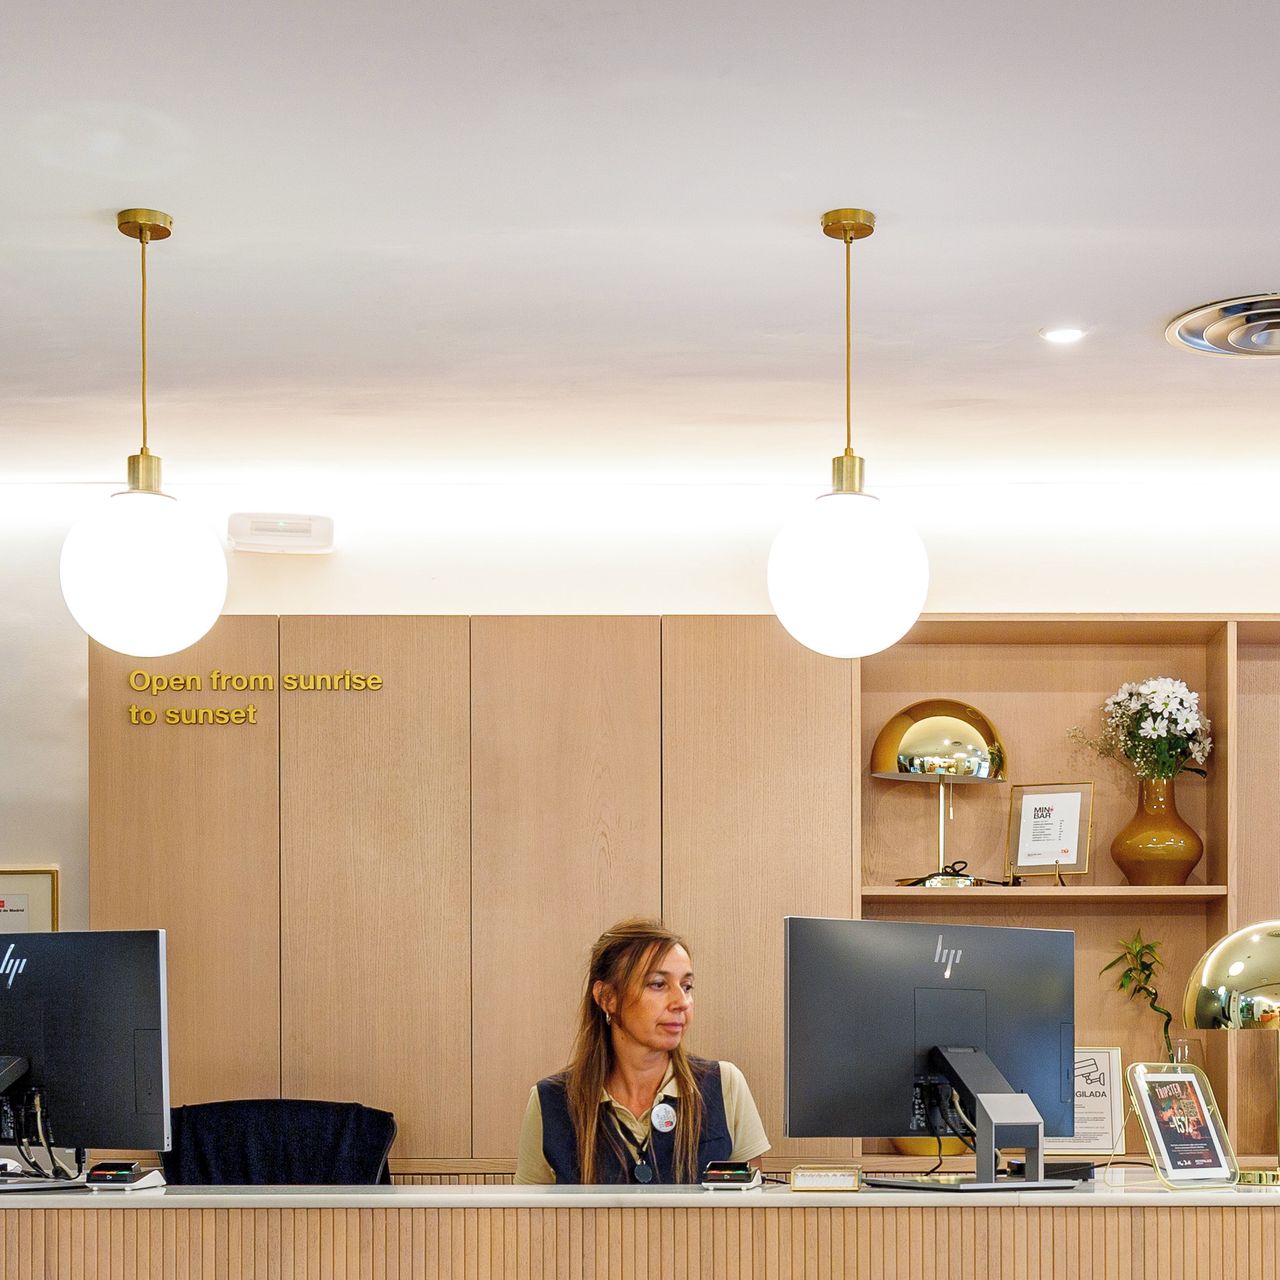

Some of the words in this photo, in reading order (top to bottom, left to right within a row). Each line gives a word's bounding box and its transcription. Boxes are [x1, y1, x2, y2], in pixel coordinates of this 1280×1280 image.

[128, 668, 202, 695] Open
[210, 668, 274, 691] from
[282, 669, 384, 691] sunrise
[128, 703, 157, 725] to
[164, 703, 257, 725] sunset
[0, 943, 27, 989] hp
[934, 934, 963, 979] hp
[1075, 1090, 1107, 1098] GILADA
